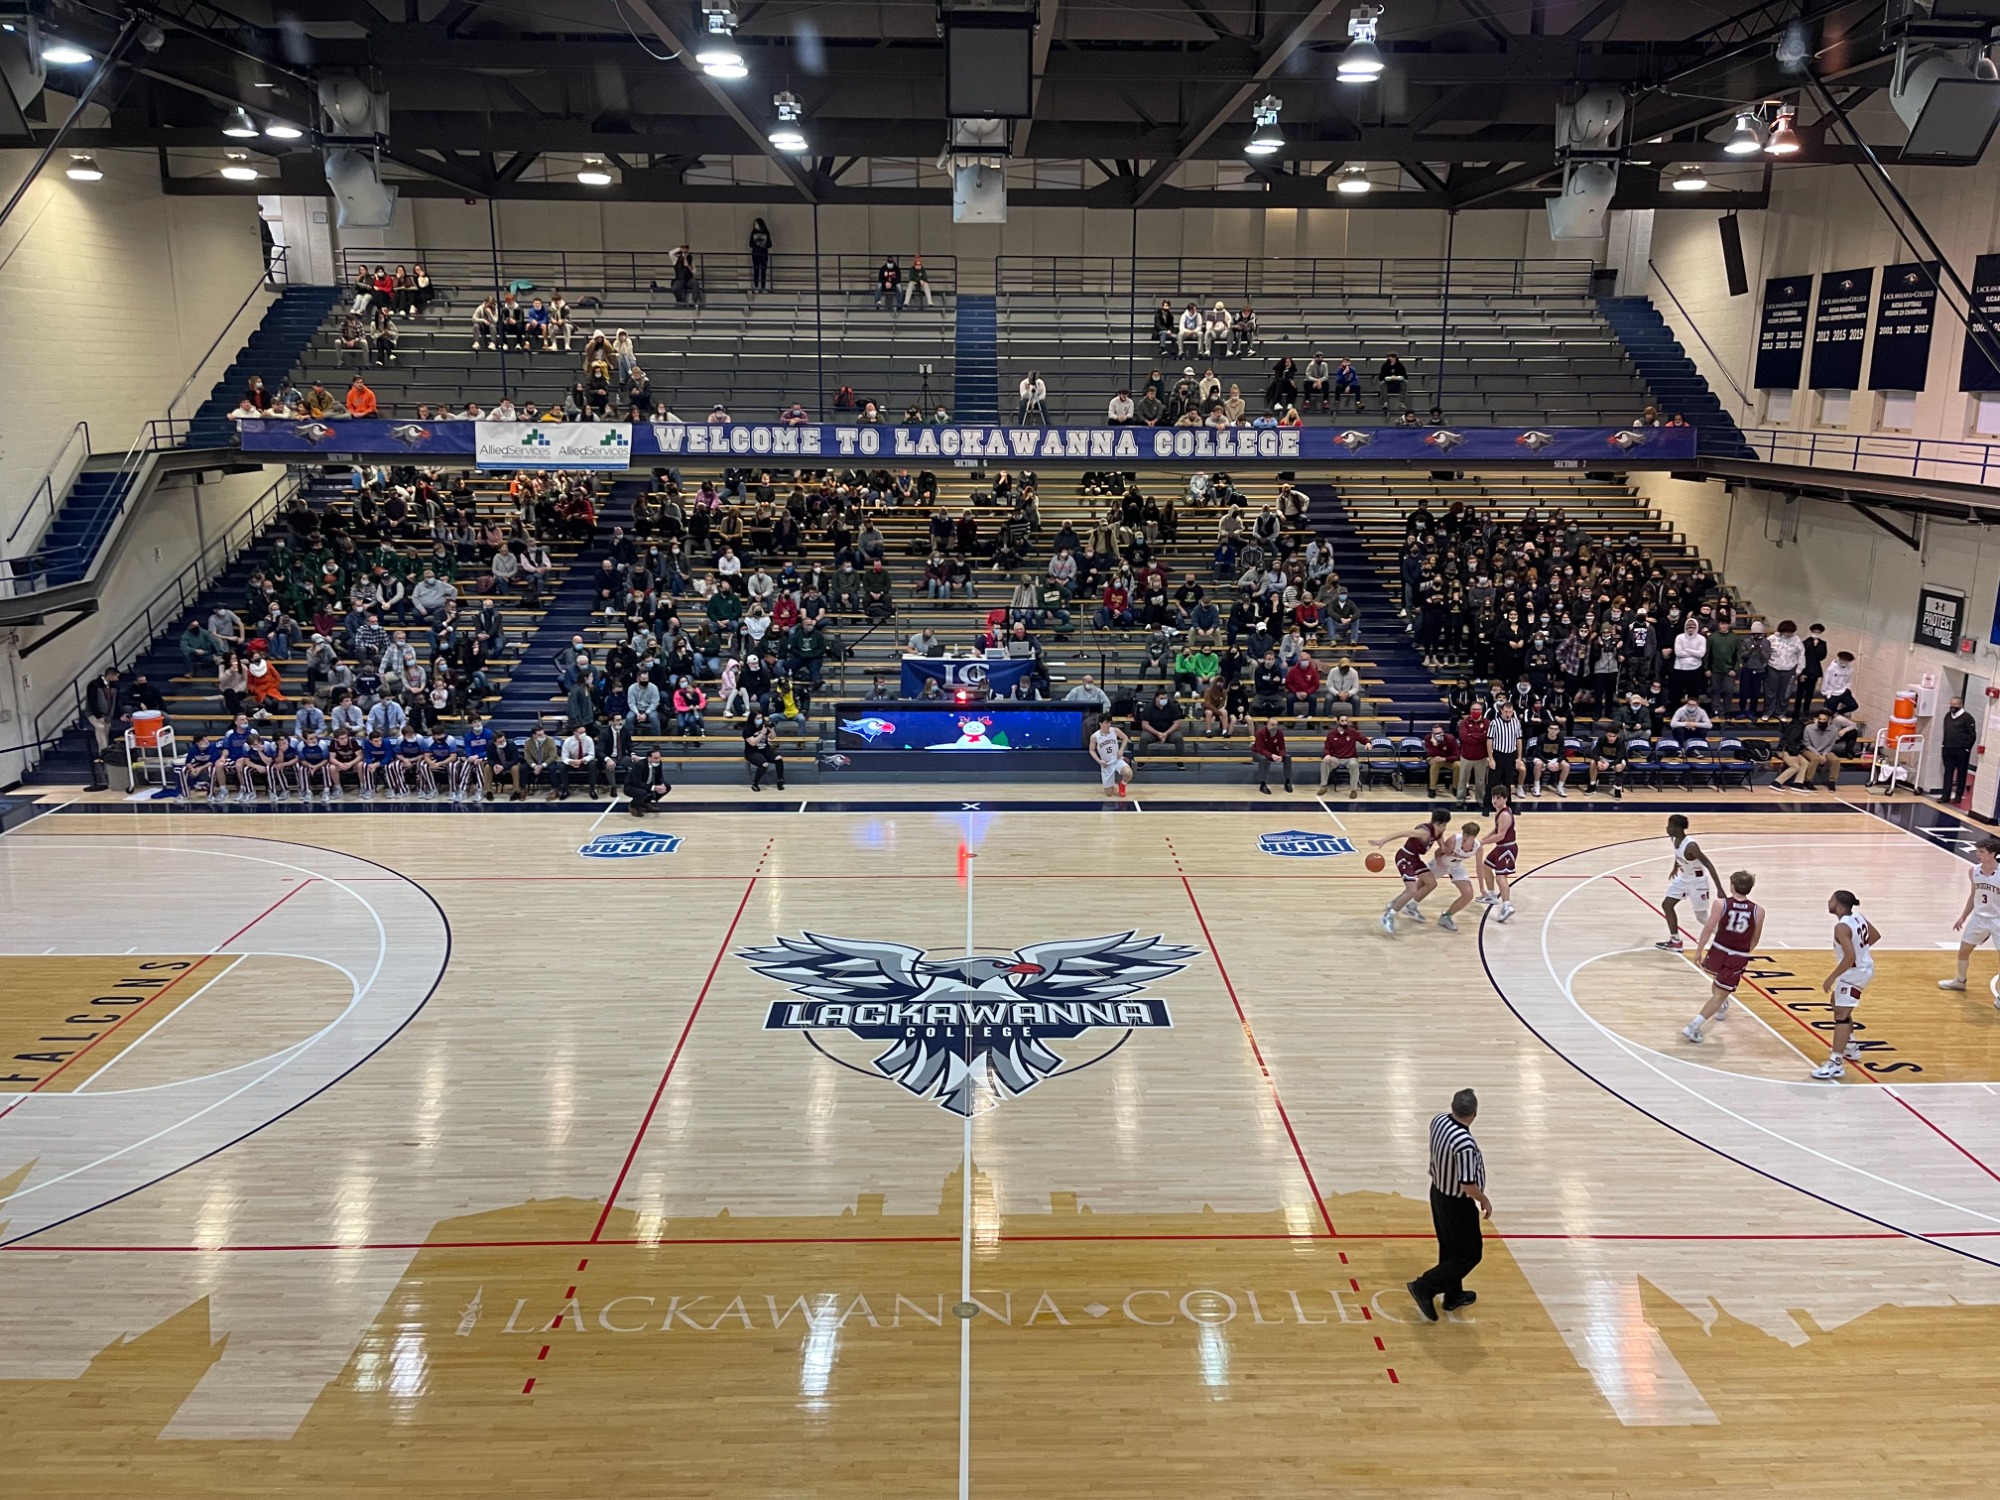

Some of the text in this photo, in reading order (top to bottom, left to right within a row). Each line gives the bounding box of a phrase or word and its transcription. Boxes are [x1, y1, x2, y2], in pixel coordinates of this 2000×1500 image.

[1816, 327, 1864, 342] 2012 2015 2019
[1914, 324, 1930, 334] 2017
[653, 426, 1300, 457] WELCOME TO LACKAWANNA COLLEGE
[480, 445, 551, 456] AlliedServices
[558, 446, 629, 456] AlliedServices
[953, 459, 978, 468] SECTION
[1922, 611, 1956, 631] PROTECT
[1921, 624, 1934, 637] THIS
[577, 838, 685, 855] NJCAA
[1259, 837, 1358, 855] NJCAA
[1982, 894, 1988, 904] 3
[1725, 910, 1752, 934] 15
[1856, 923, 1869, 949] 32
[0, 961, 192, 1083] FALCONS
[783, 1002, 1154, 1028] LACKAWANNA
[905, 1026, 1033, 1039] COLLEGE
[501, 1290, 1072, 1334] LACKAWANNA
